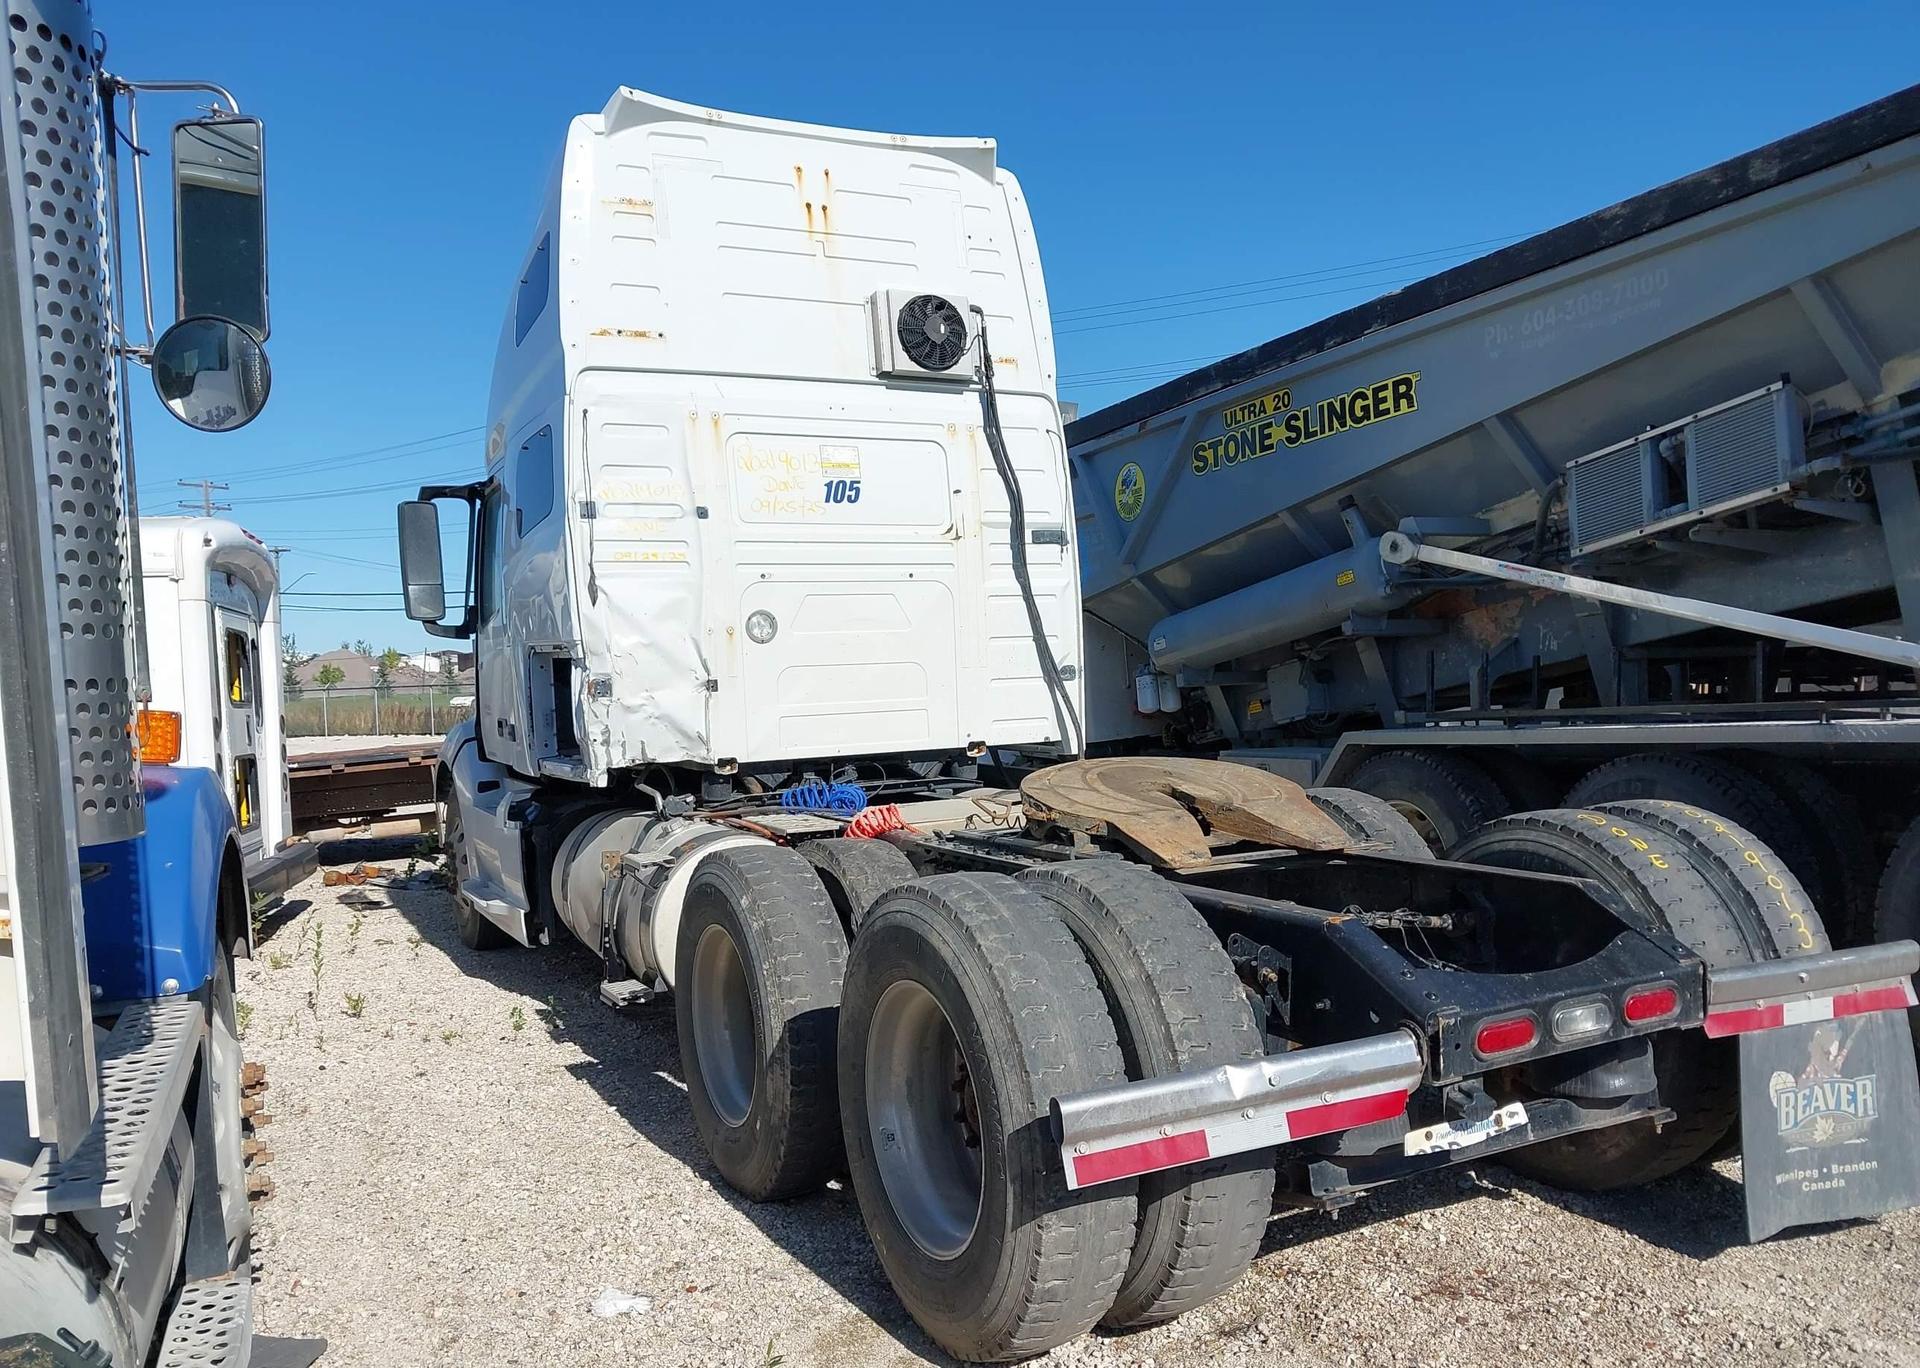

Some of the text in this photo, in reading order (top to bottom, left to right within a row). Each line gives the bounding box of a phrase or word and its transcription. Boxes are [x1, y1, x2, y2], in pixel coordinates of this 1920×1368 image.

[1193, 422, 1275, 475] STONE
[1284, 376, 1417, 448] SLINGER
[1224, 391, 1291, 429] ULTRA 20
[824, 480, 861, 503] 105
[1779, 1078, 1875, 1131] BEAVER
[1776, 1160, 1878, 1185] Winnipeg Brandon
[1802, 1178, 1845, 1193] Canada
